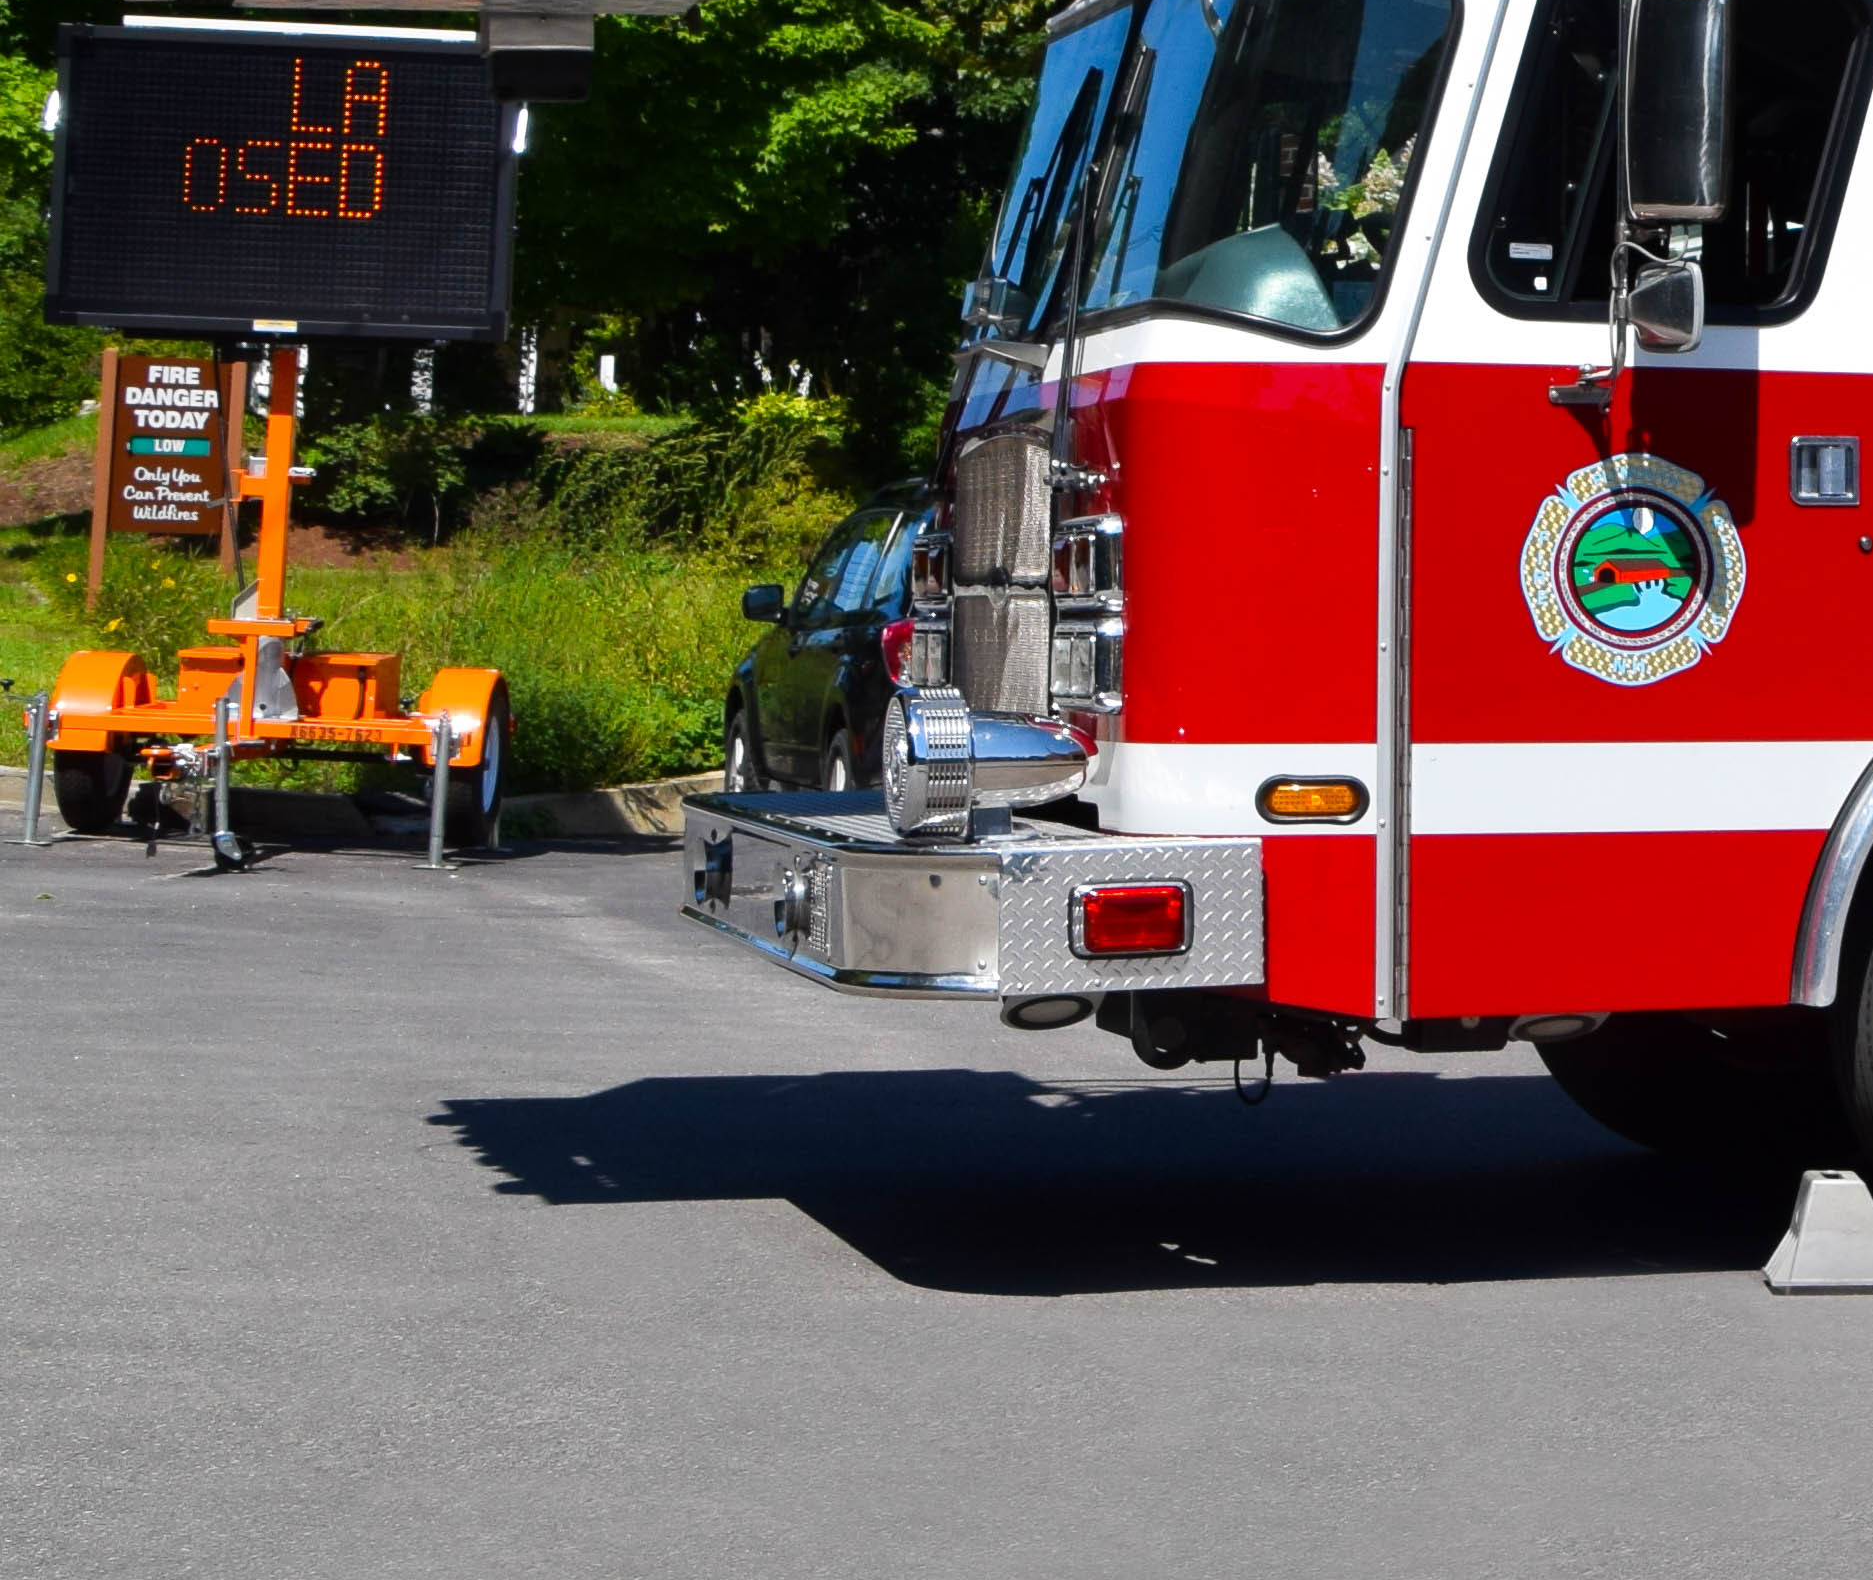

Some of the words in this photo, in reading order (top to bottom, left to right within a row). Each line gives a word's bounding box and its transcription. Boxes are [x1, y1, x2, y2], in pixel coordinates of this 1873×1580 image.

[290, 57, 388, 135] LA
[182, 137, 386, 220] OSED
[148, 365, 200, 385] FIRE
[125, 387, 218, 408] DANGER
[133, 410, 210, 429] TODAY
[153, 439, 185, 453] LOW
[134, 467, 170, 485] Only
[172, 468, 200, 486] You
[123, 485, 154, 500] Can
[155, 486, 210, 502] Prevent
[133, 505, 198, 521] Wildfires
